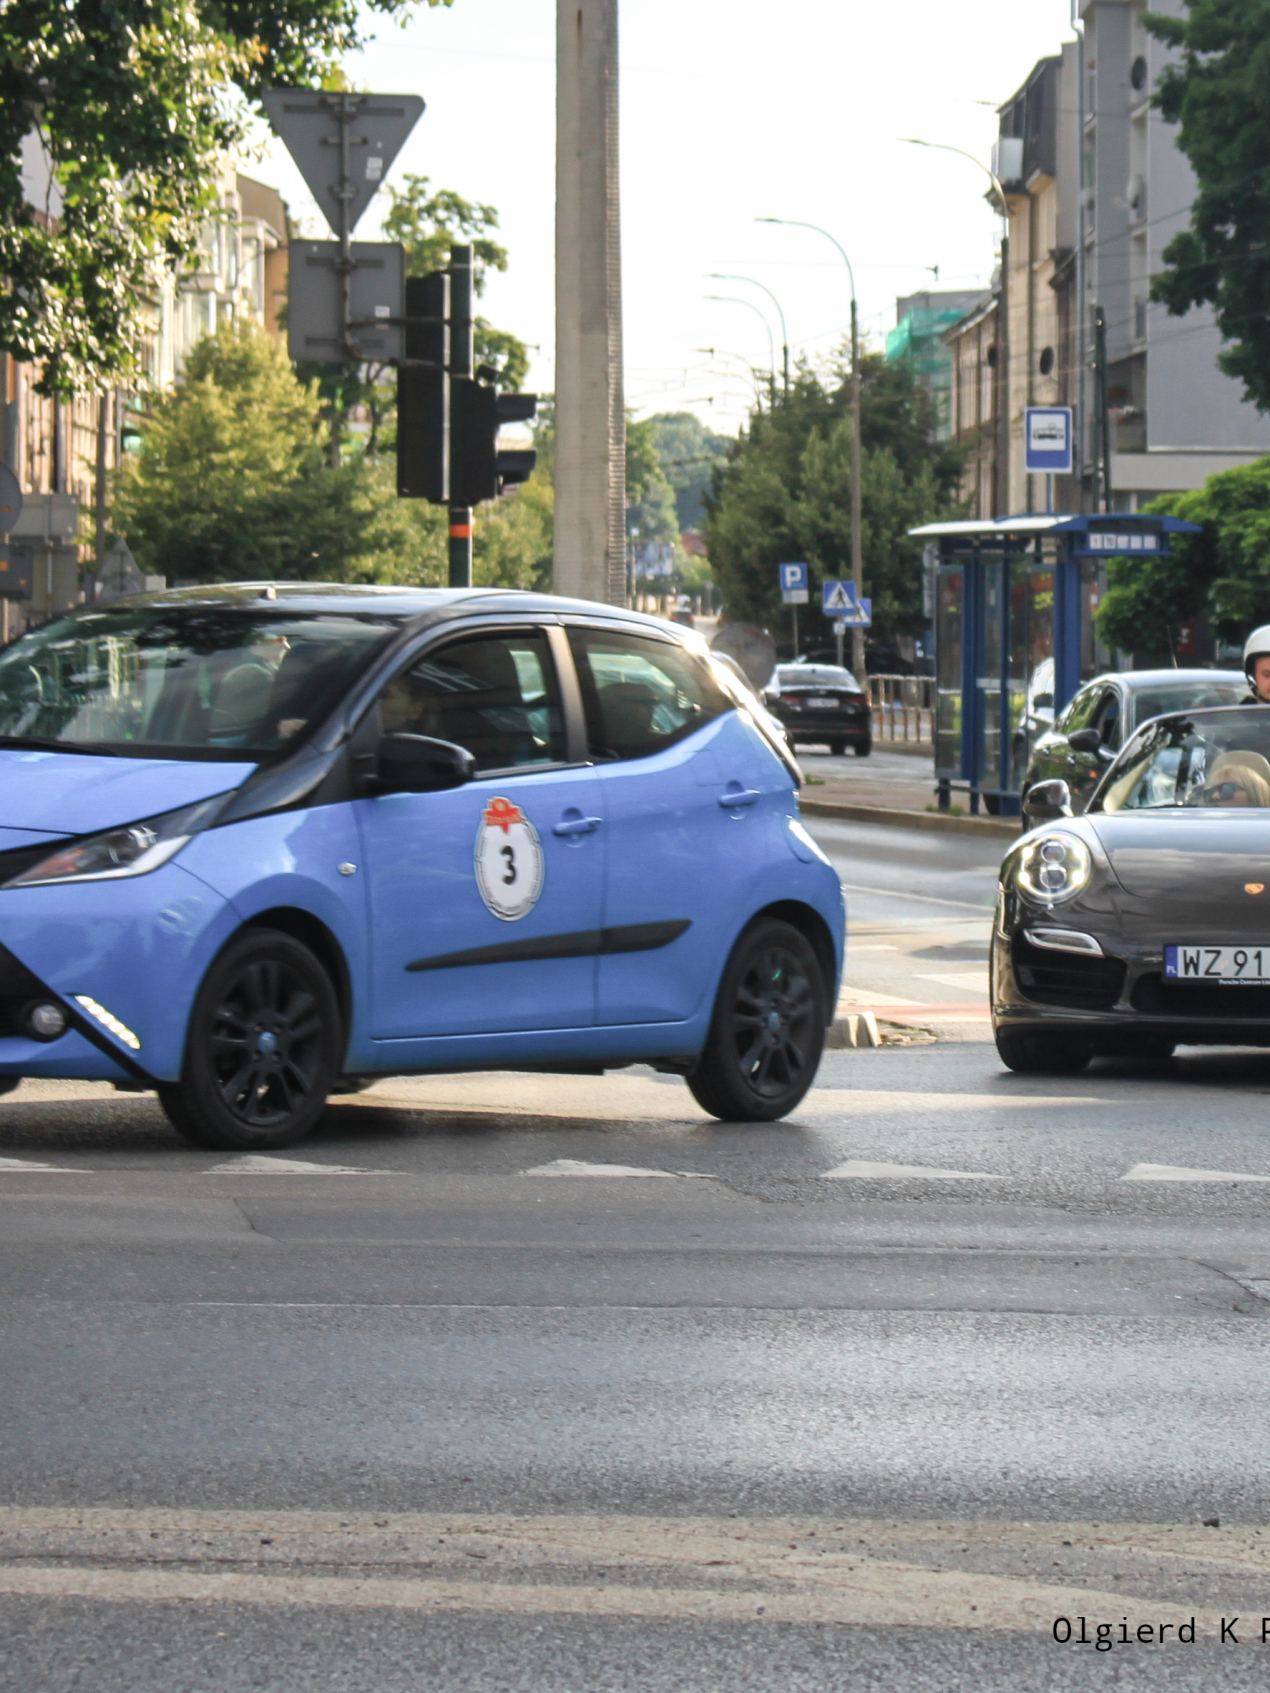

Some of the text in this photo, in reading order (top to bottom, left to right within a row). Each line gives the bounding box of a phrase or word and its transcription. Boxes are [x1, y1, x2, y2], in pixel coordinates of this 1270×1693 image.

[785, 566, 802, 587] P
[501, 845, 516, 885] 3
[1166, 965, 1177, 974] PL
[1183, 949, 1222, 976] WZ
